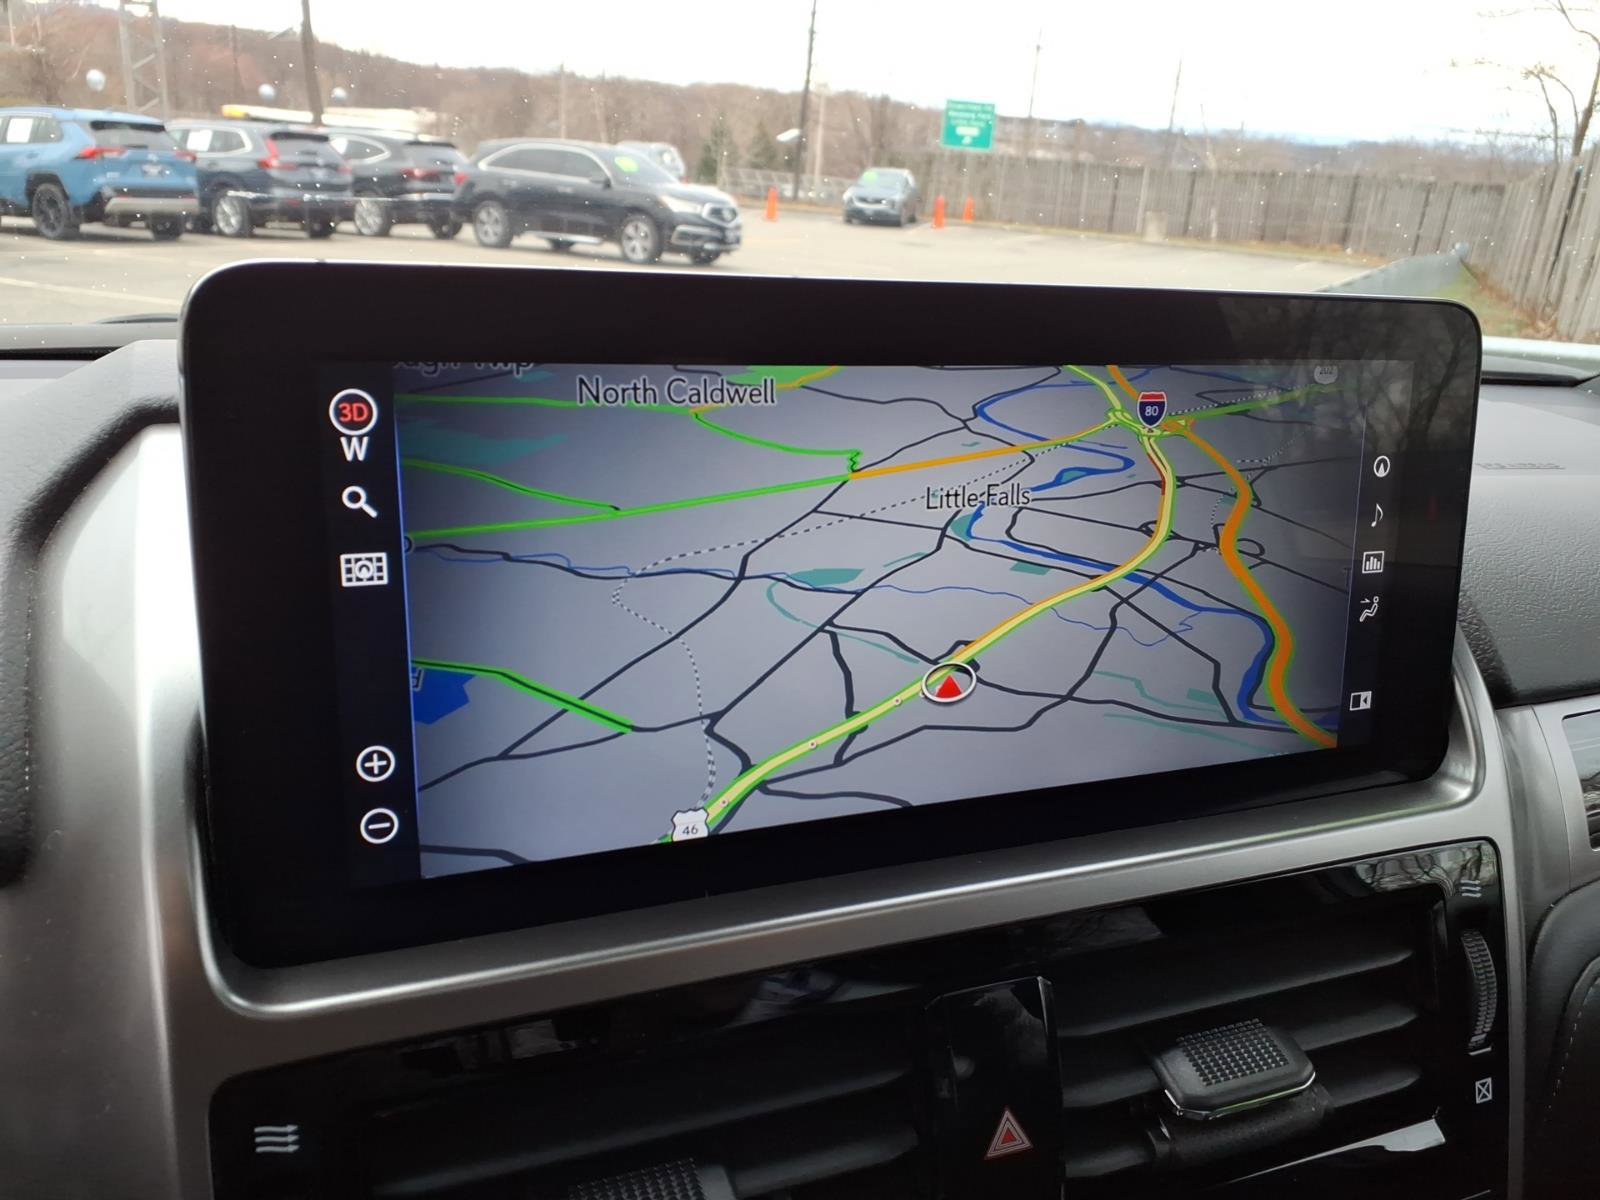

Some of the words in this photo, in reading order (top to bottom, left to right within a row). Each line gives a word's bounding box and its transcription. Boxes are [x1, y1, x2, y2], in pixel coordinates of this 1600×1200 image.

[577, 376, 658, 405] North
[666, 376, 776, 405] Caldwell
[337, 402, 369, 422] 3D
[1144, 405, 1159, 417] 80
[339, 436, 369, 462] W
[926, 484, 979, 510] Little
[986, 482, 1031, 507] Falls
[682, 824, 699, 836] 46
